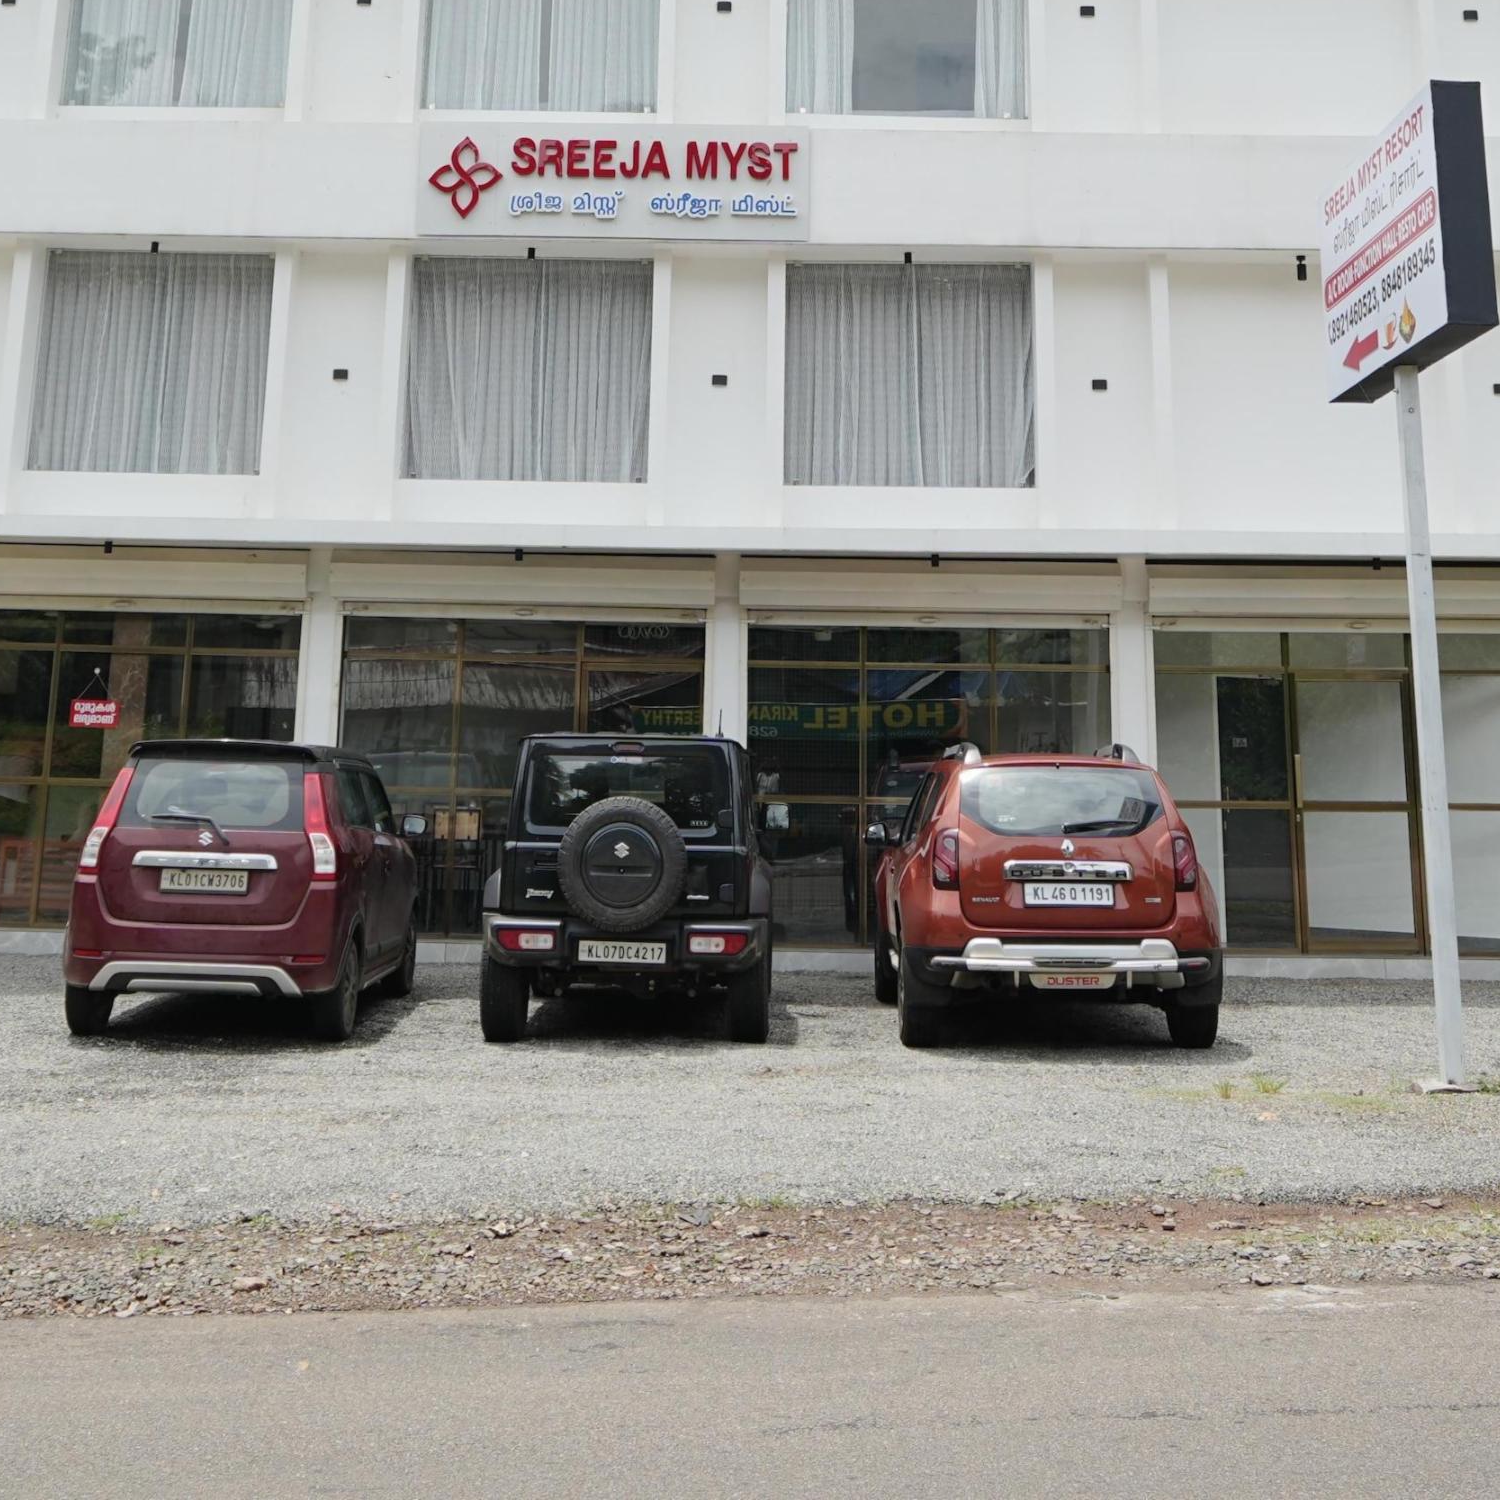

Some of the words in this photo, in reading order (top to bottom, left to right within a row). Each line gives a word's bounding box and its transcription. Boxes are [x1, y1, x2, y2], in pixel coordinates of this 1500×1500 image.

[510, 137, 670, 179] SREEJA
[686, 142, 798, 180] MYST
[1324, 177, 1357, 226] SREEJA
[1358, 146, 1382, 193] MYST
[1385, 105, 1423, 166] RESORT
[510, 193, 562, 215] ശ്രീജ
[731, 195, 797, 216] மிஸ்ட்
[1417, 195, 1433, 228] CAFE
[1382, 238, 1435, 302] 8848189345
[169, 872, 245, 888] KL01CW3706
[1011, 869, 1127, 878] DUSTER
[1033, 887, 1048, 901] KL
[1052, 887, 1066, 900] 46
[1081, 888, 1111, 901] 1191
[587, 945, 664, 961] KL07DC4217
[1047, 976, 1100, 986] DUSTER
